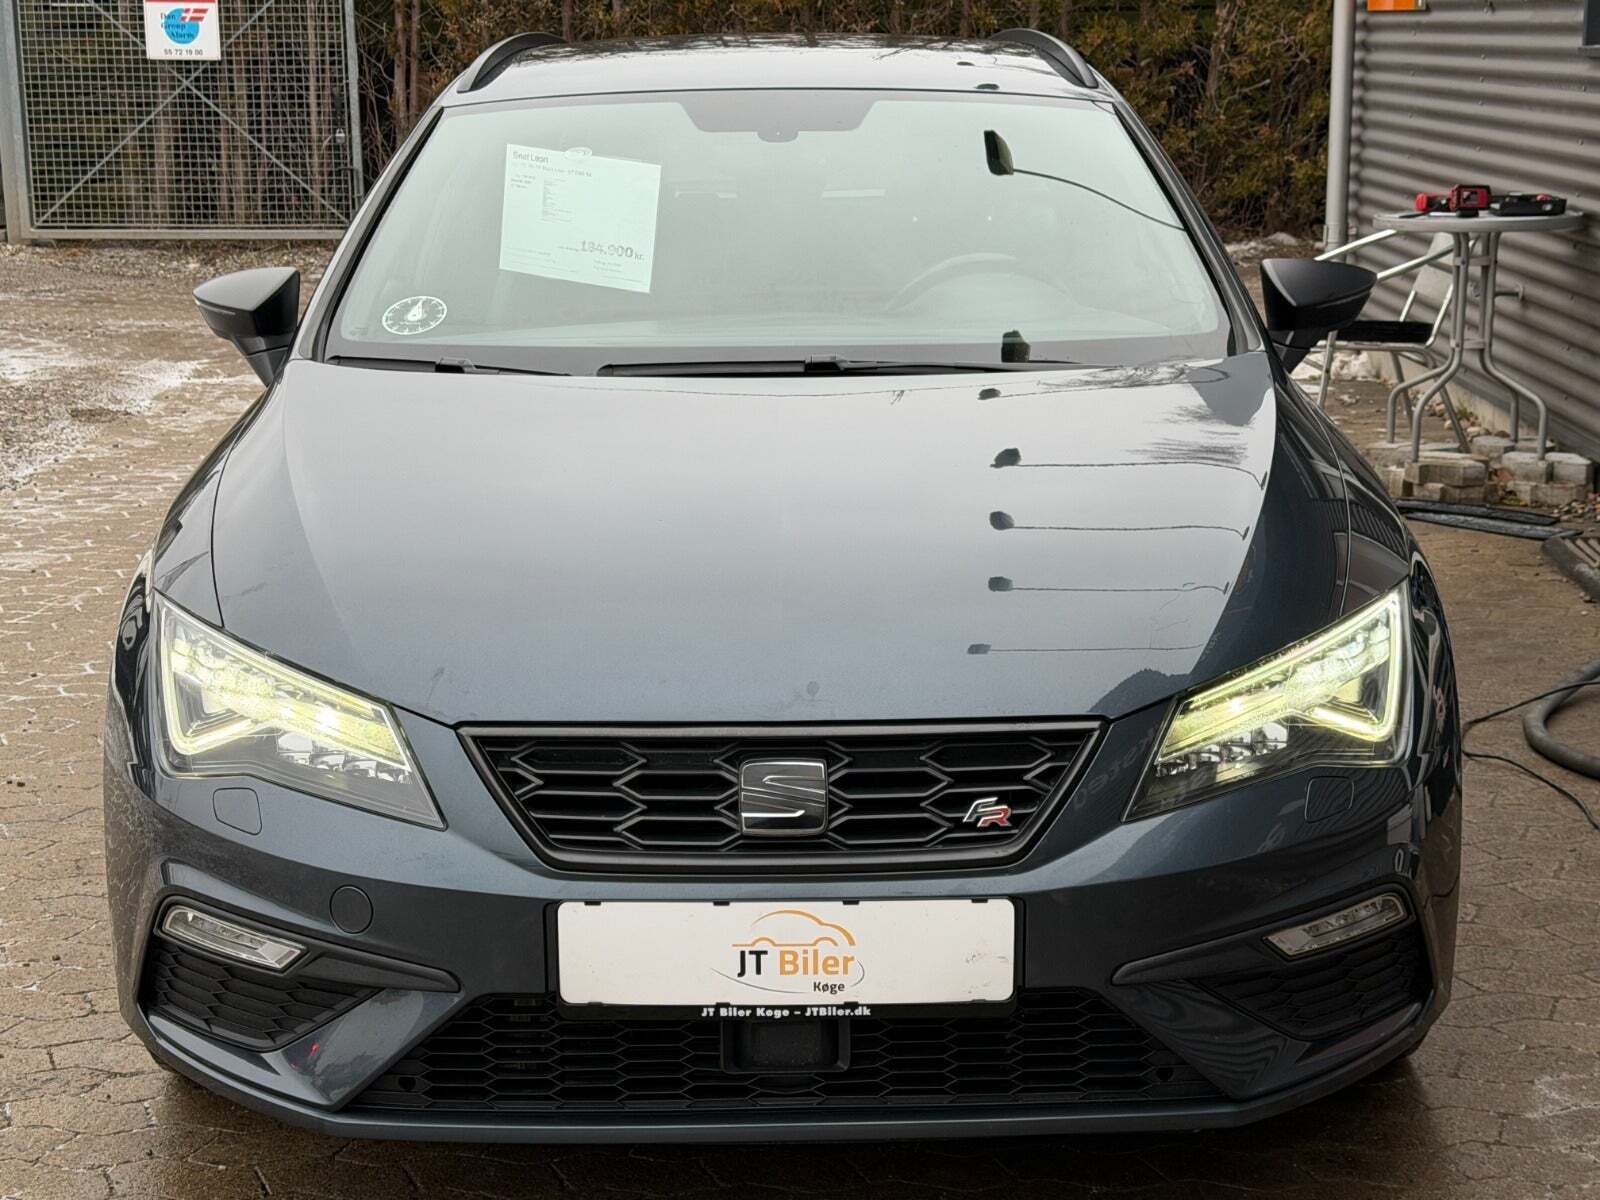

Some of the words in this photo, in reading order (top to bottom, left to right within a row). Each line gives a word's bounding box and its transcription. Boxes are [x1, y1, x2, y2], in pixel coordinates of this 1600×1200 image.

[160, 12, 176, 20] Dan
[160, 23, 186, 32] Group
[175, 48, 183, 56] 72
[737, 949, 768, 978] JT
[778, 949, 856, 977] Biler
[813, 981, 846, 995] Køge
[701, 1007, 716, 1017] JT
[719, 1006, 752, 1017] Biler
[804, 1006, 872, 1017] JTBiler.dk
